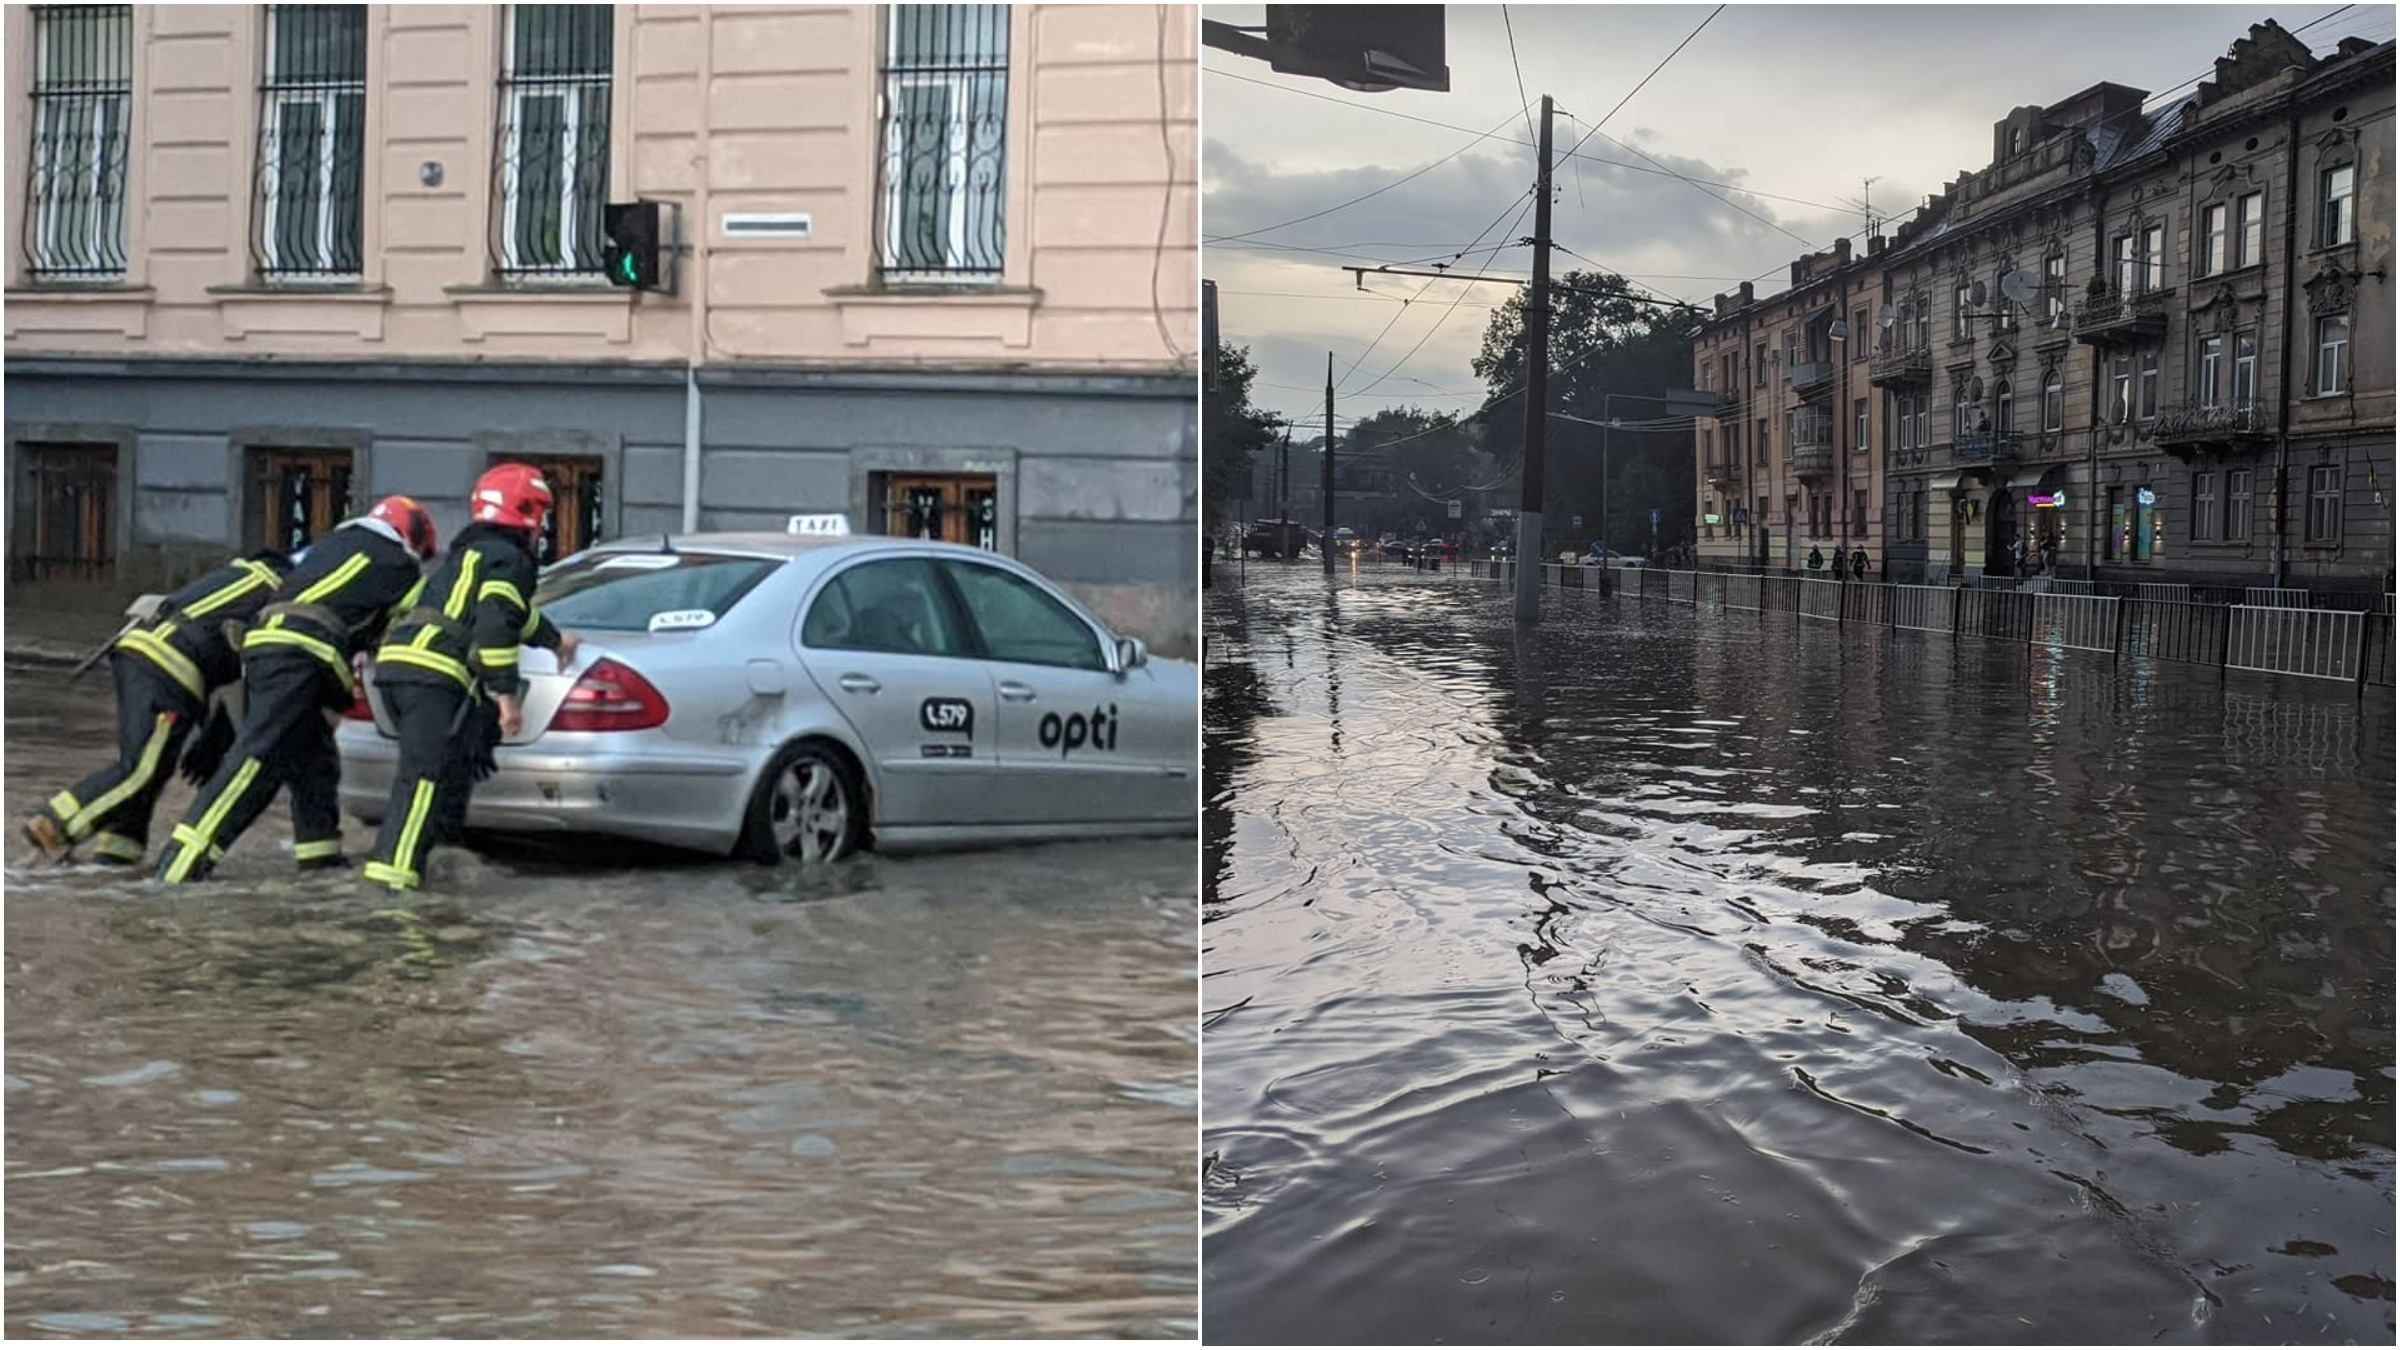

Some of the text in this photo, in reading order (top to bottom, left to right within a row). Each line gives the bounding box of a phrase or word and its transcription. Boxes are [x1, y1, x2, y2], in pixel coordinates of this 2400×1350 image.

[796, 519, 837, 533] TAXI
[938, 704, 968, 727] 579
[1038, 703, 1118, 759] opti
